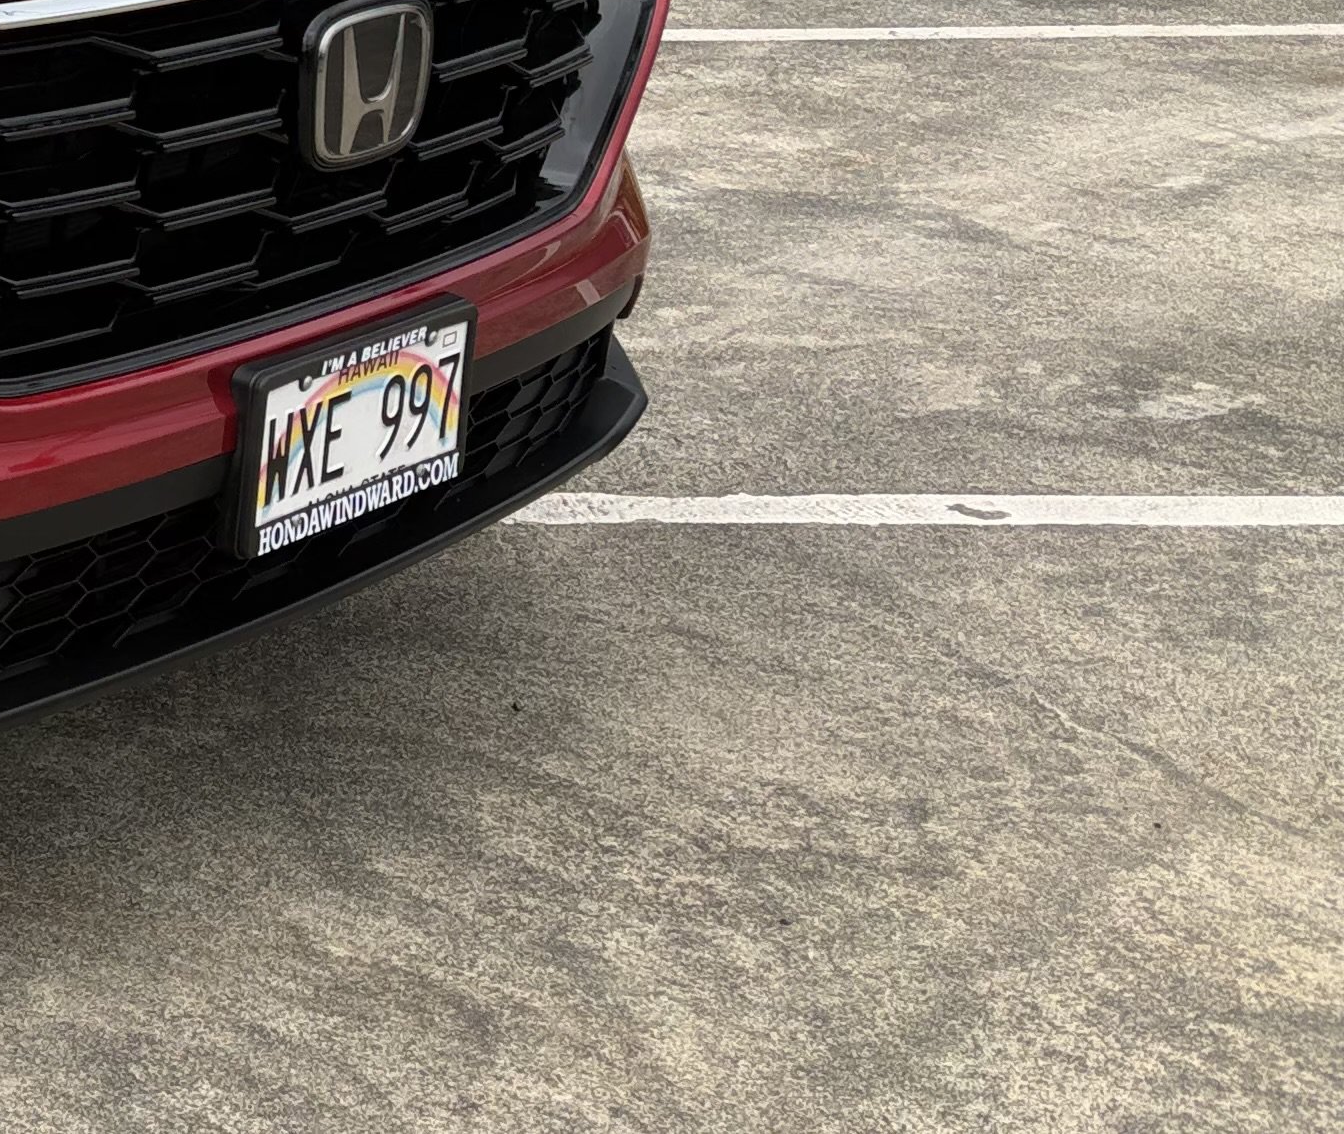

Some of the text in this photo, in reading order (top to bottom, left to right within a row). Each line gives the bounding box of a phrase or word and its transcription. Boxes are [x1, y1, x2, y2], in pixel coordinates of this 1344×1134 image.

[321, 325, 429, 376] I'M A BELIEVER
[337, 350, 400, 386] HAWAII
[263, 351, 461, 509] WXE 997
[257, 451, 460, 557] HONDAWINDWARD.COM
